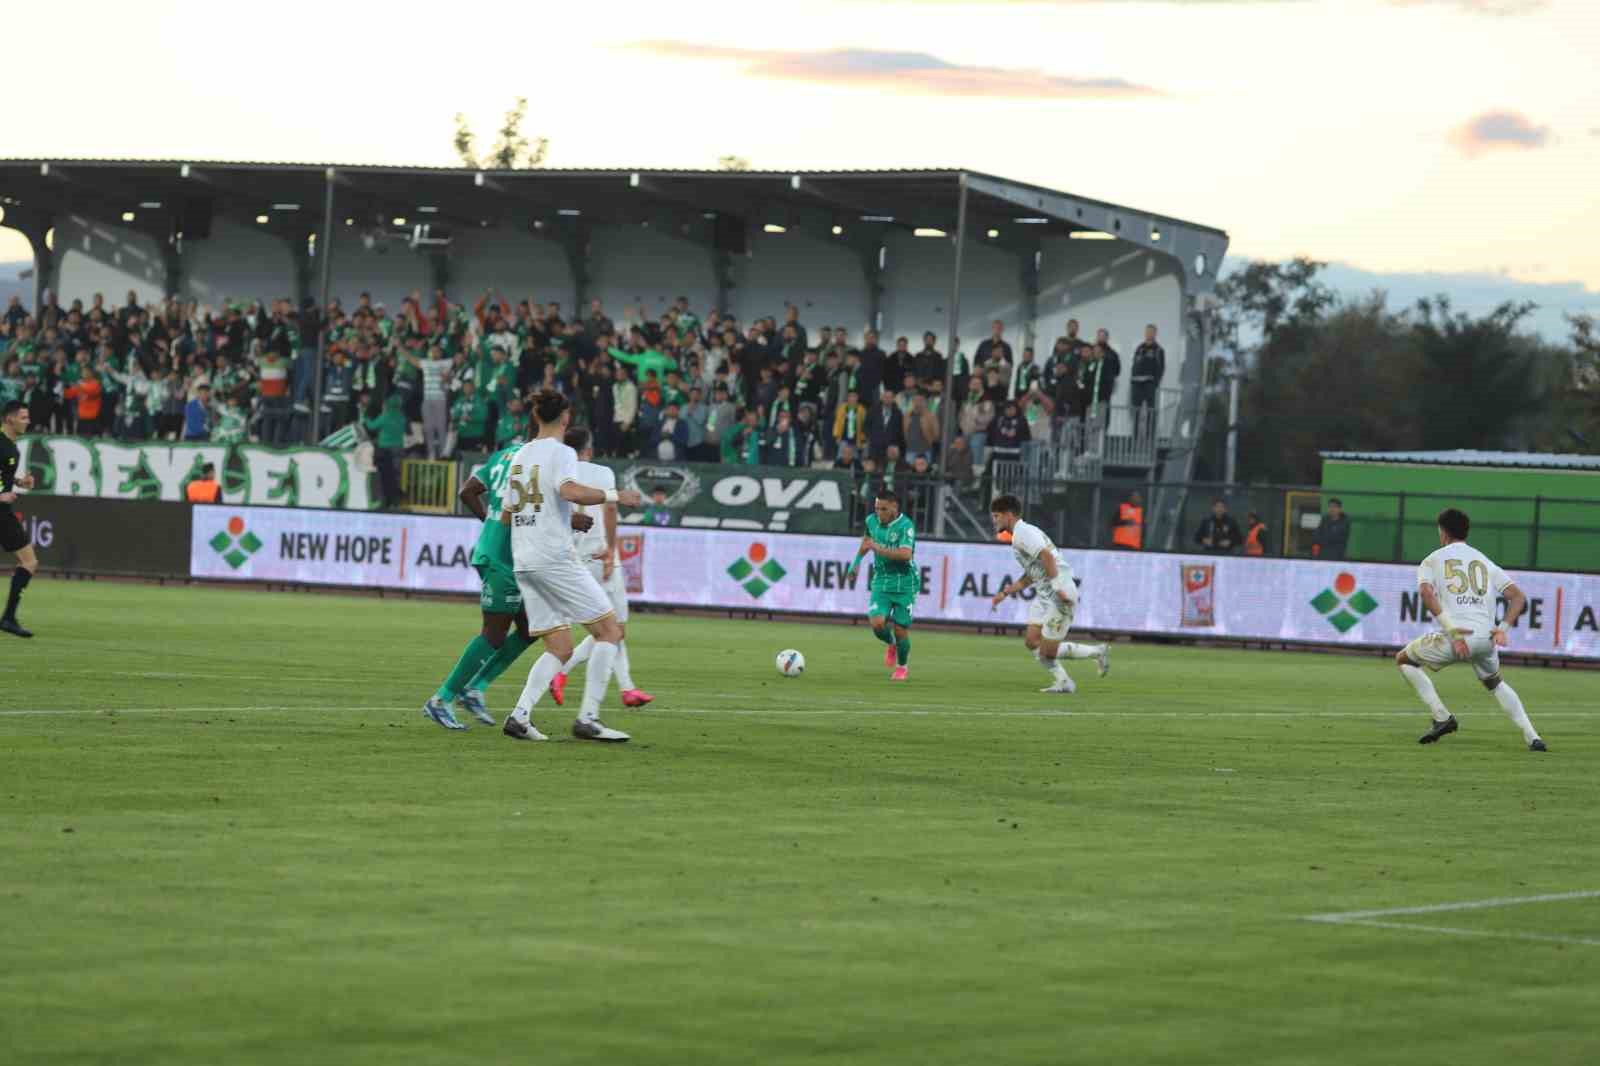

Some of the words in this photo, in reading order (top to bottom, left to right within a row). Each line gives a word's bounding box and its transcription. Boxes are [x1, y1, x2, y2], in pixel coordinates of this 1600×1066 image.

[511, 464, 545, 513] 54
[712, 475, 843, 511] OVA
[279, 532, 328, 561] NEW
[335, 534, 392, 565] HOPE
[415, 543, 474, 570] ALA
[805, 559, 858, 591] NEW
[1444, 558, 1489, 596] 50
